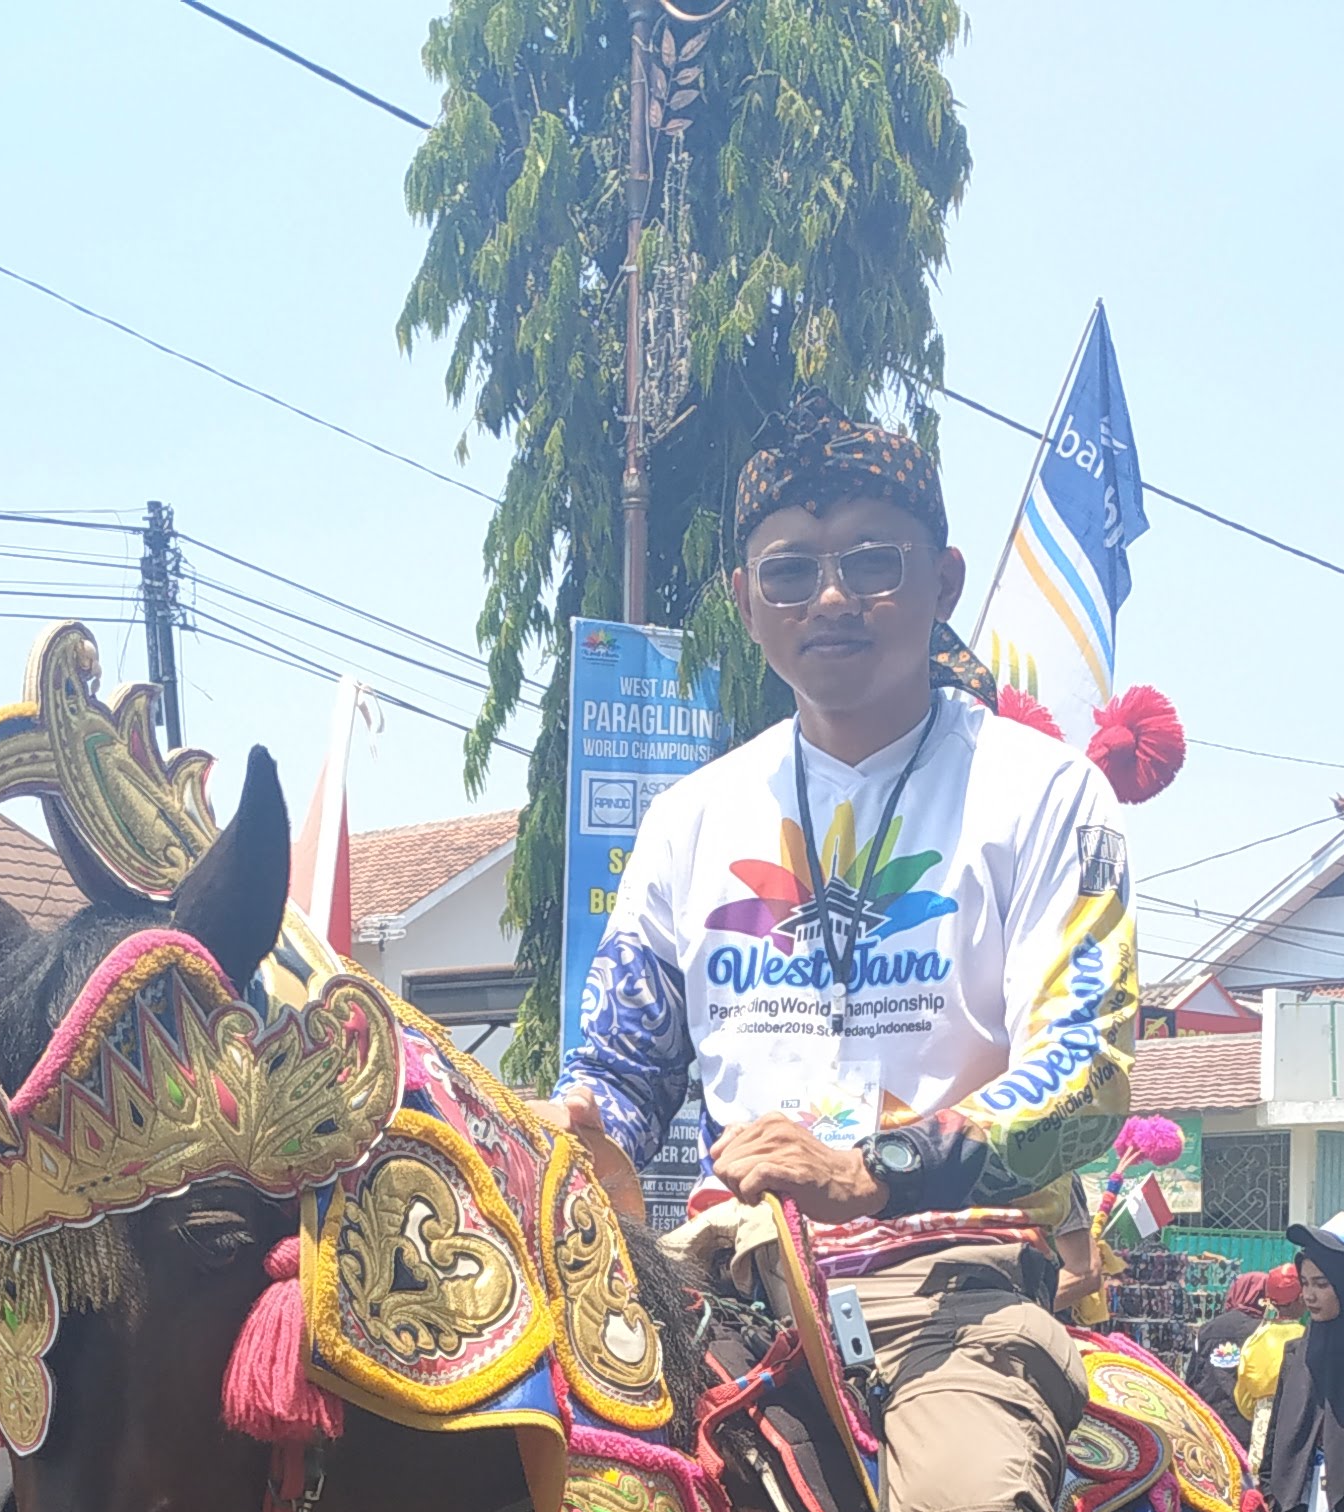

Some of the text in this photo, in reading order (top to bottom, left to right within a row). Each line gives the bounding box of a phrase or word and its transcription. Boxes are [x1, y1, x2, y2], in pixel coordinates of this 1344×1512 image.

[619, 676, 658, 697] WEST
[582, 737, 629, 758] WORLD
[707, 939, 952, 994] West Java
[780, 996, 832, 1018] World
[844, 992, 945, 1019] hampionship
[1013, 1082, 1093, 1150] Paragliding
[642, 1180, 656, 1191] ART
